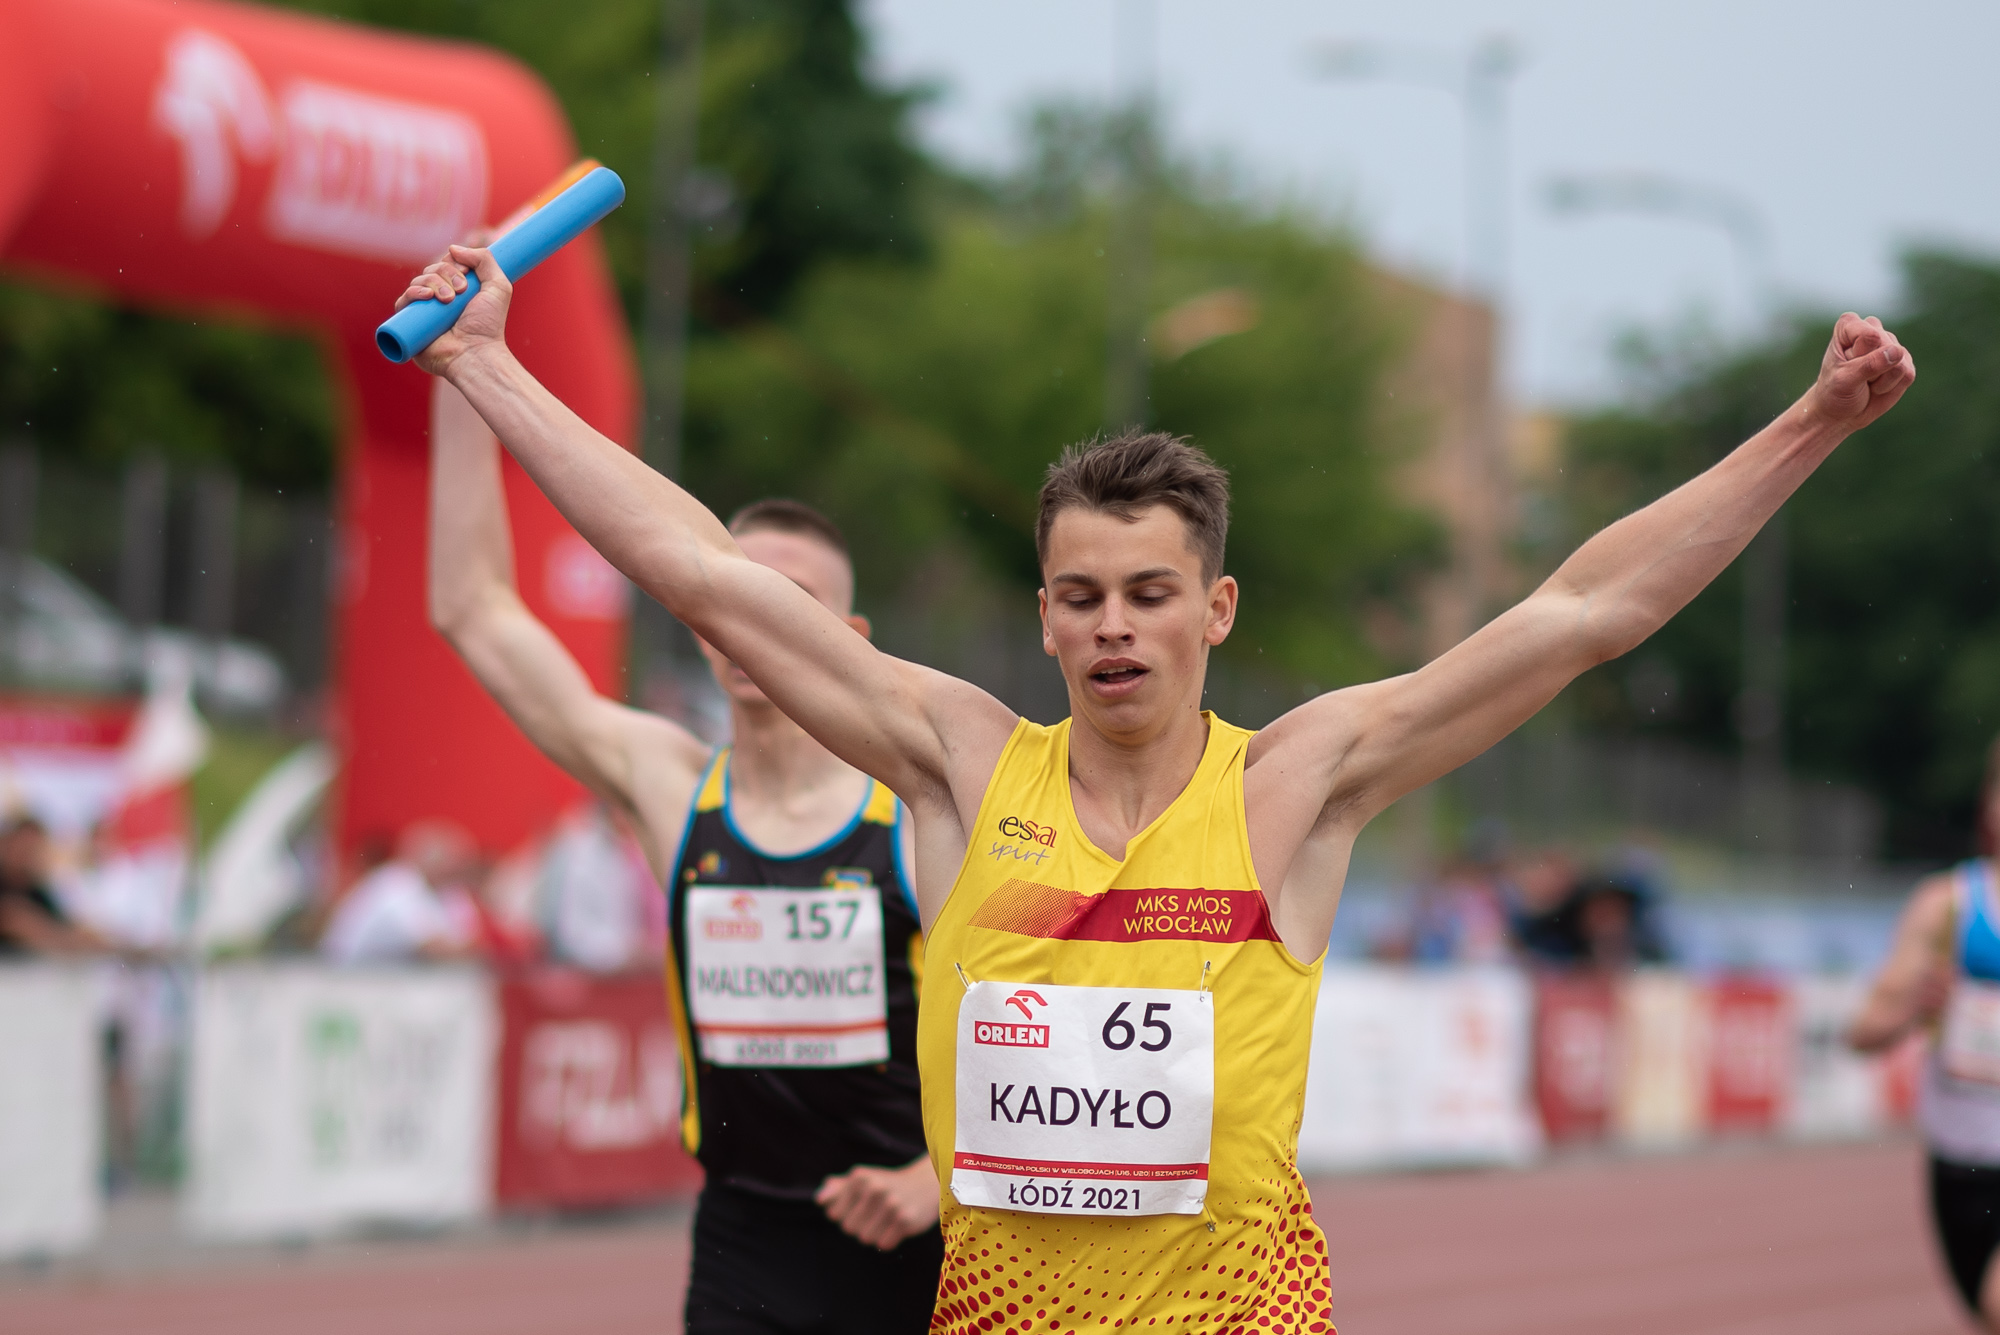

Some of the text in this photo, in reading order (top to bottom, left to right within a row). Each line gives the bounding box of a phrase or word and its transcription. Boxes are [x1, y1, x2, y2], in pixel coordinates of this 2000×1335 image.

[785, 900, 860, 940] 157
[1135, 894, 1232, 915] MKS MOS
[1123, 915, 1232, 936] WROCŁAW
[697, 964, 874, 998] MALENDOWICZ
[977, 1023, 1046, 1046] ORLEN
[1101, 1001, 1172, 1052] 65
[990, 1081, 1172, 1130] KADYŁO
[981, 1161, 1025, 1172] MISTRZOSTWA
[1026, 1165, 1051, 1173] POLSKI
[1061, 1167, 1115, 1176] WIELOBOJACH
[1155, 1169, 1199, 1177] SZTAFETACH
[1008, 1178, 1141, 1210] ŁÓDŹ 2021
